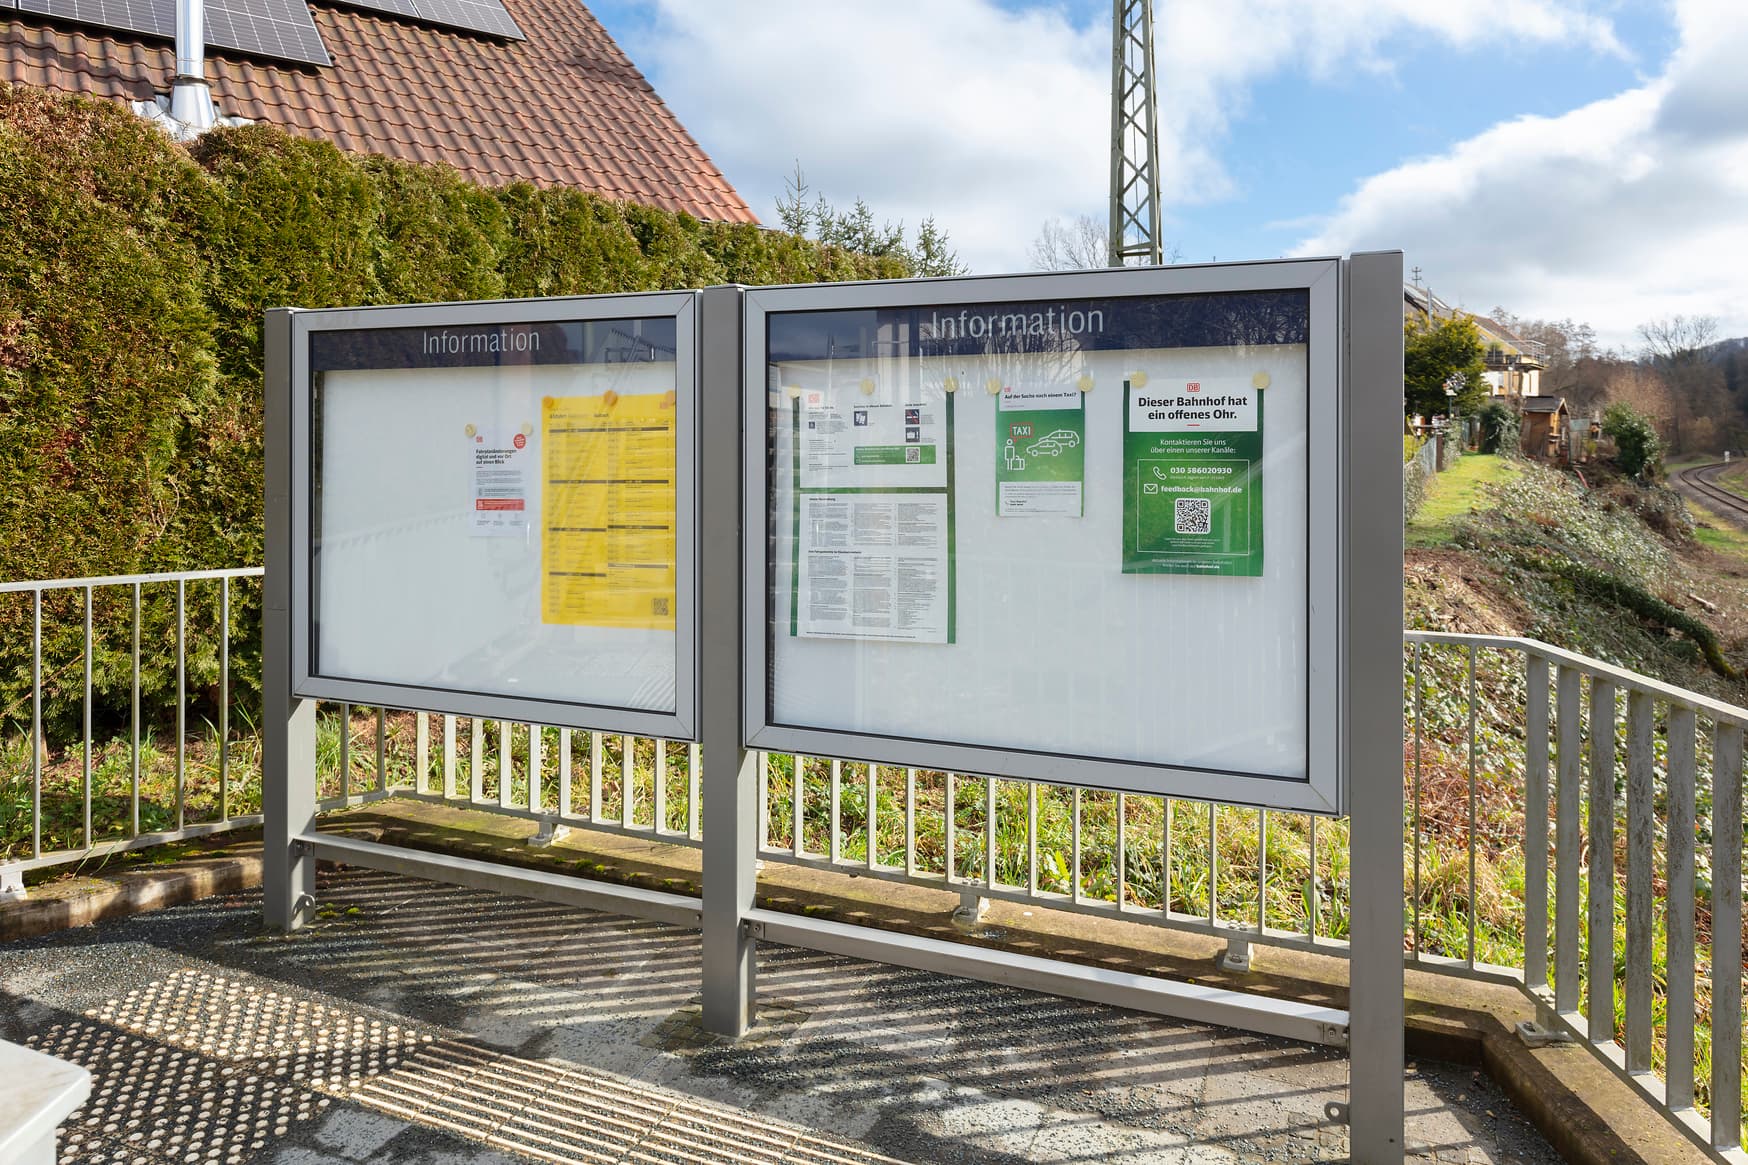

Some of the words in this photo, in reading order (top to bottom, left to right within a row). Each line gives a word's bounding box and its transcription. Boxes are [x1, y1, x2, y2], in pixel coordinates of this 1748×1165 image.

[930, 305, 1104, 338] Information
[423, 328, 540, 354] Information
[1187, 383, 1200, 392] DB
[1138, 397, 1174, 407] Dieser
[1176, 396, 1226, 407] Bahnhof
[1228, 396, 1248, 406] hat
[1148, 410, 1165, 420] ein
[1168, 409, 1210, 420] offenes
[1213, 409, 1237, 419] Ohr.
[1012, 426, 1031, 436] TAXI
[1150, 446, 1165, 454] über
